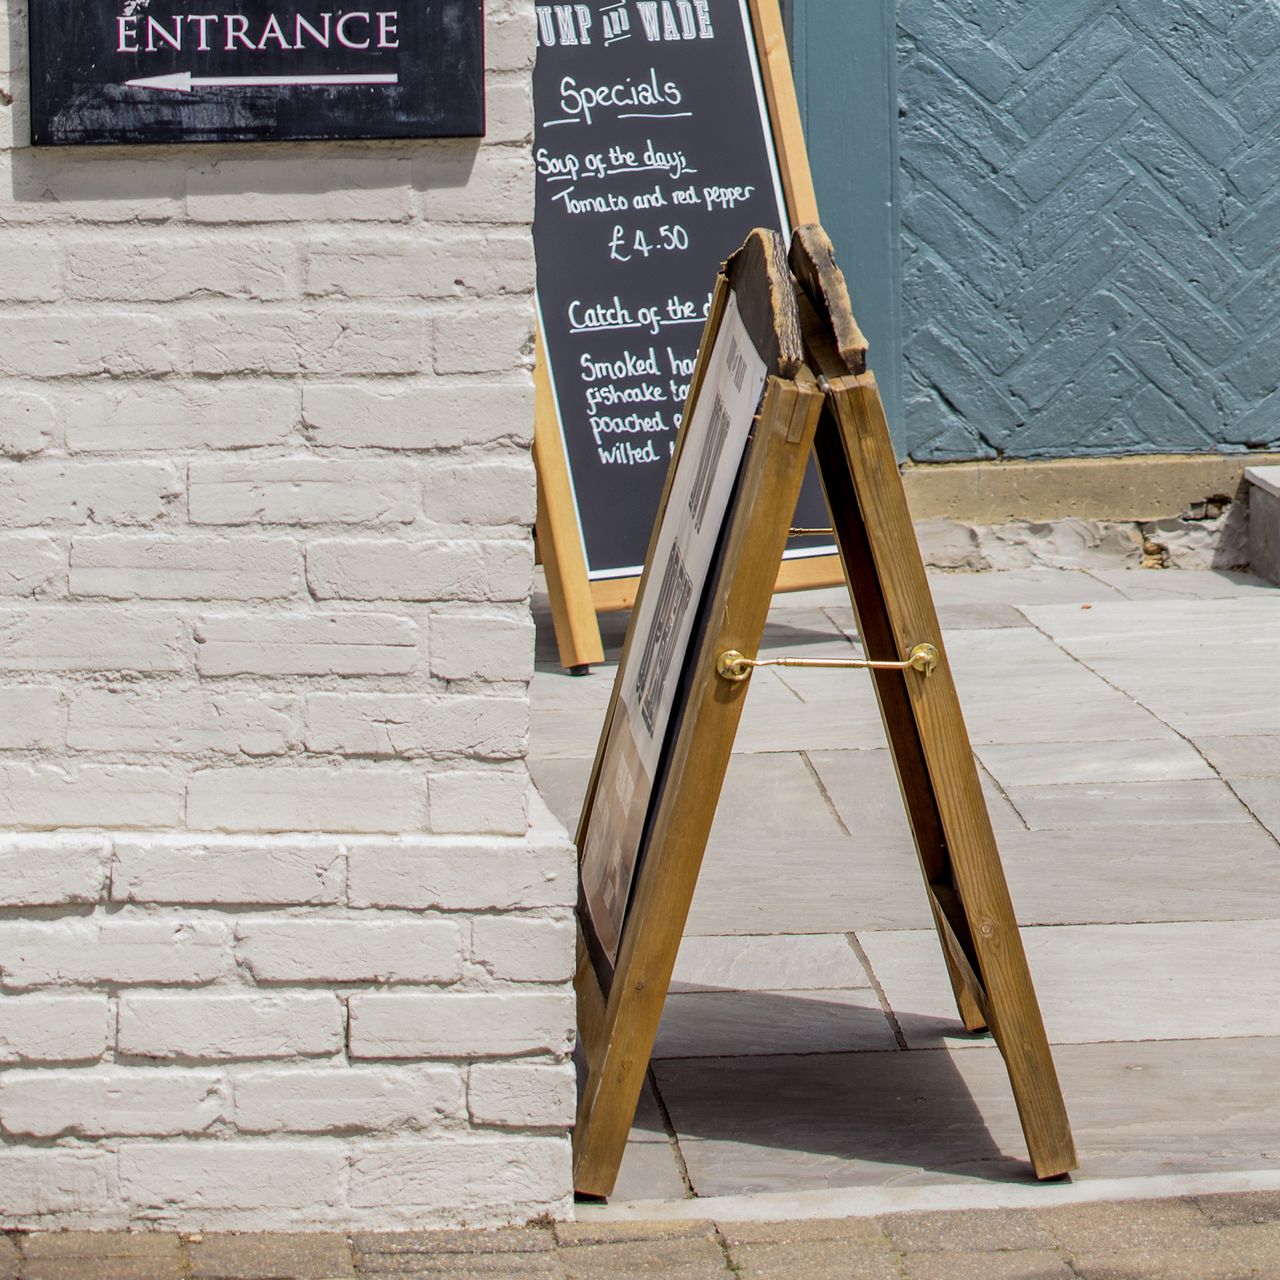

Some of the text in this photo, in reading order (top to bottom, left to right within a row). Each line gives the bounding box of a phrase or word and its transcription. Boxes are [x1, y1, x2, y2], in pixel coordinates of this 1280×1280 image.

[115, 11, 400, 53] ENTRANCE
[536, 3, 592, 47] UMP
[602, 7, 630, 39] AND
[560, 67, 682, 124] Specials
[536, 148, 579, 180] Soup
[585, 153, 607, 179] of
[608, 145, 639, 167] the
[552, 185, 756, 214] Tomato and red pepper
[568, 295, 634, 329] Catch
[637, 306, 661, 335] of
[666, 295, 697, 320] the
[580, 347, 661, 381] Smoked
[586, 382, 668, 416] fishcake
[589, 411, 670, 445] poached
[598, 439, 661, 466] wilted
